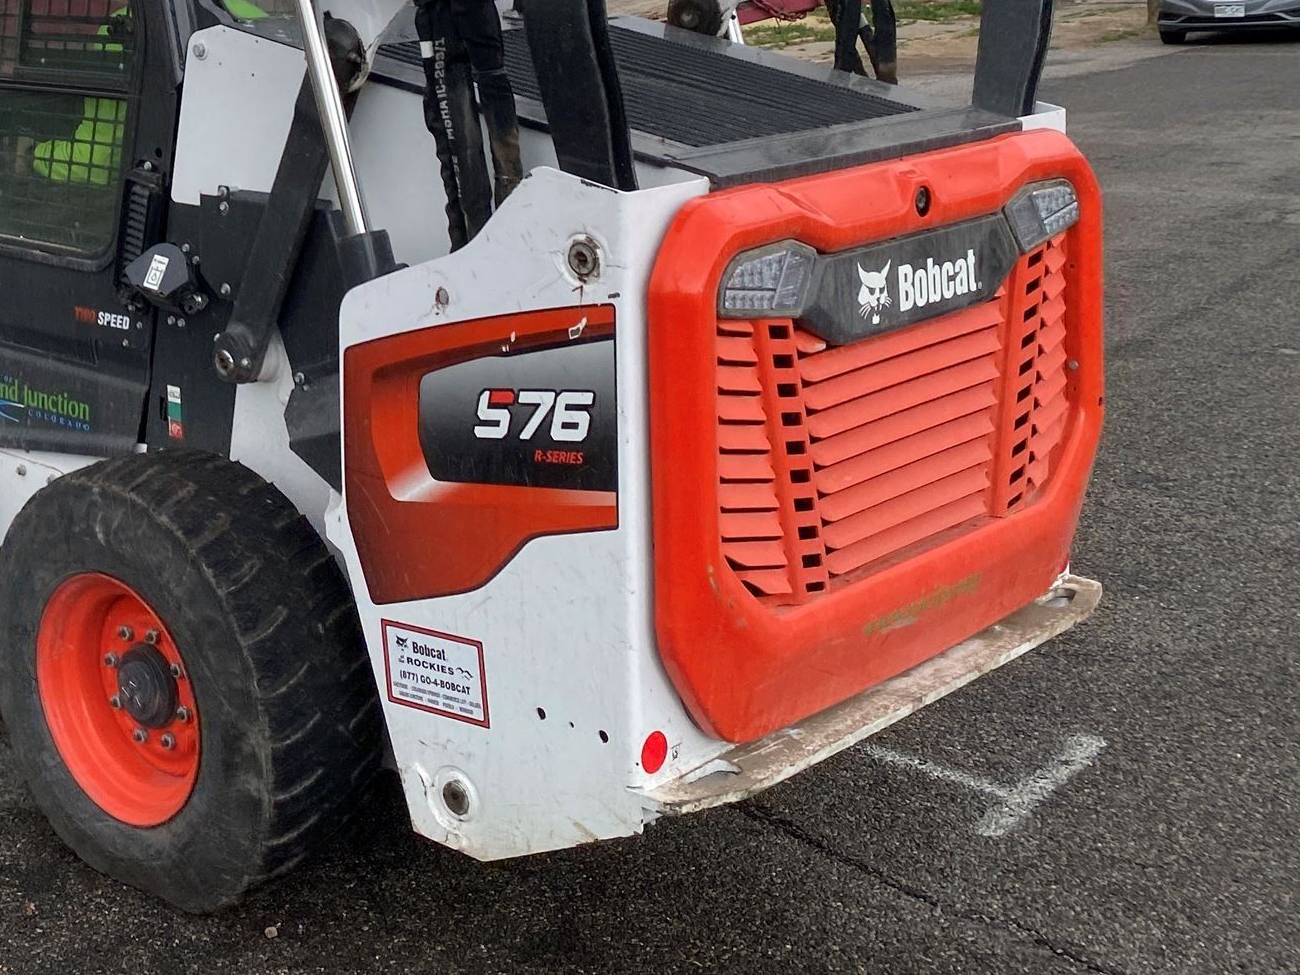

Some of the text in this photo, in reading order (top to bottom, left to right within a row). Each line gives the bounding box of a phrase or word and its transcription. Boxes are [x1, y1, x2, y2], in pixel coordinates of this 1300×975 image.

[898, 248, 977, 312] Bobcat
[97, 311, 130, 330] SPEED
[23, 384, 90, 421] Junction
[28, 409, 91, 432] COLORADO
[474, 390, 594, 442] S76
[534, 449, 584, 465] R-SERIES
[412, 641, 446, 661] Bobcat
[406, 656, 455, 676] ROCKIES
[399, 670, 419, 684] (877)
[420, 674, 471, 696] GO-4-BOBCAT
